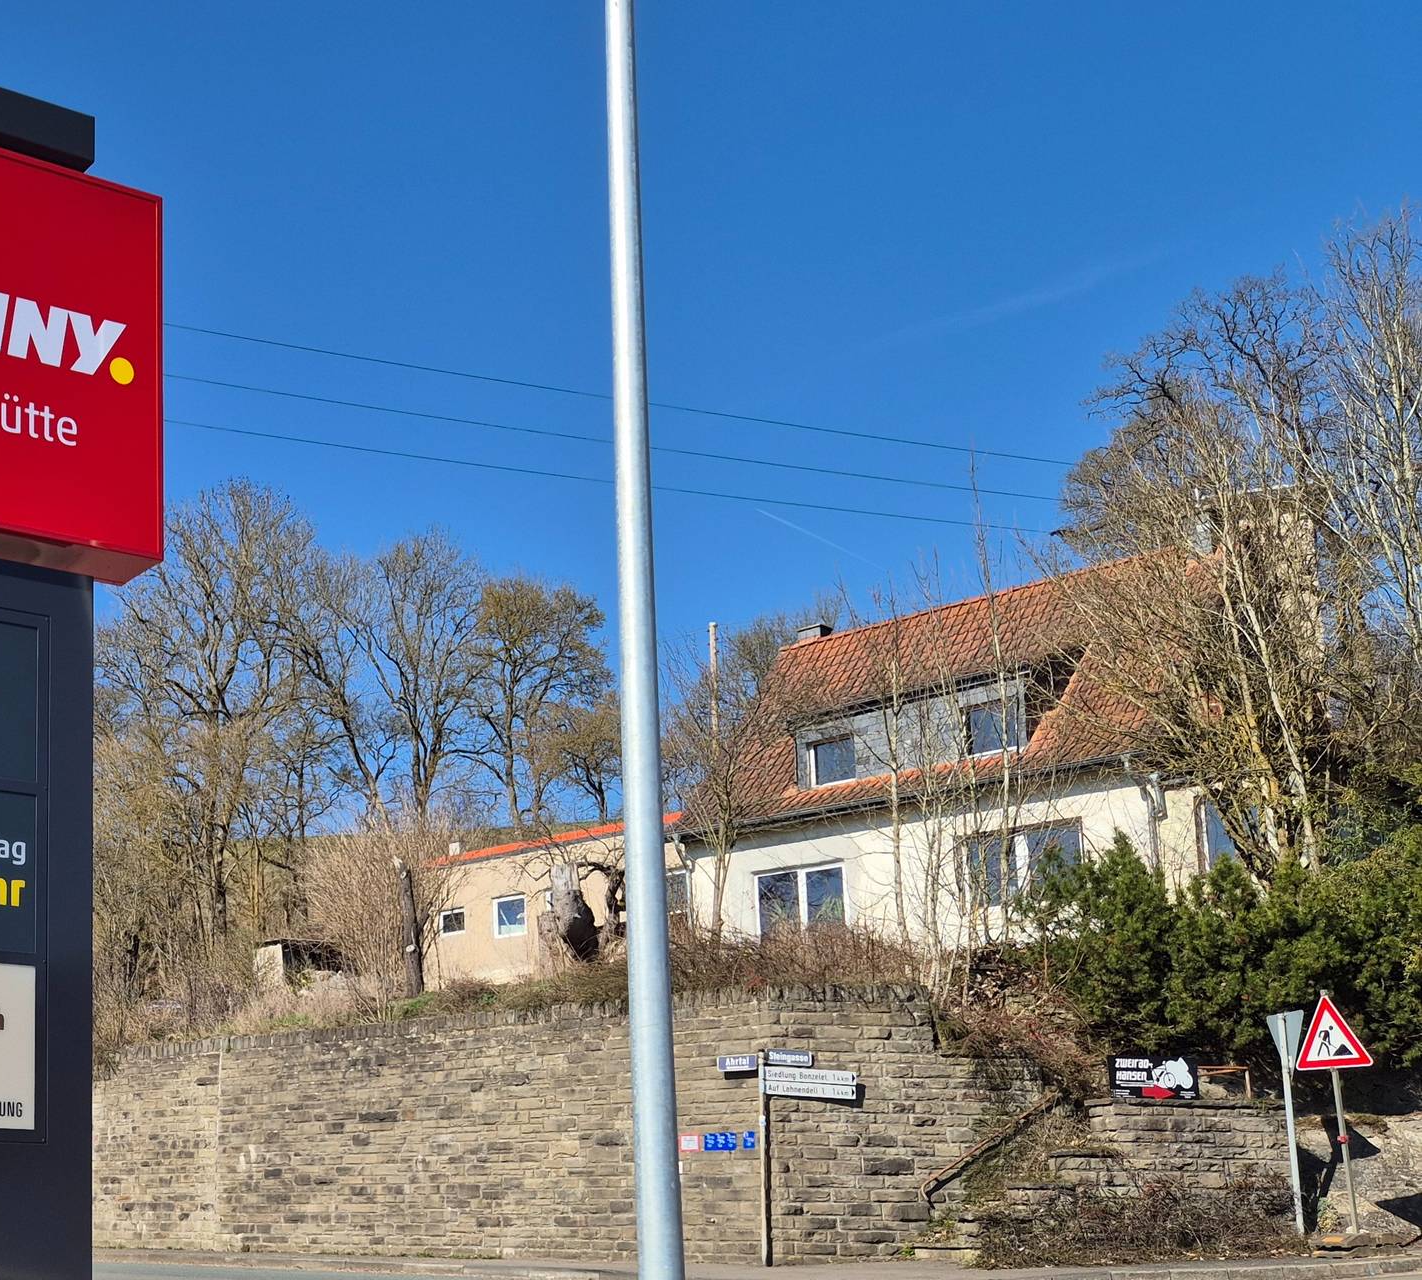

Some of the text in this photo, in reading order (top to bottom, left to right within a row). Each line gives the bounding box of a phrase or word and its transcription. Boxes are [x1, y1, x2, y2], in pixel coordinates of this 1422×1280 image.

[768, 1052, 809, 1063] Steingasse
[767, 1069, 797, 1081] Siedlung
[768, 1084, 779, 1092] Auf
